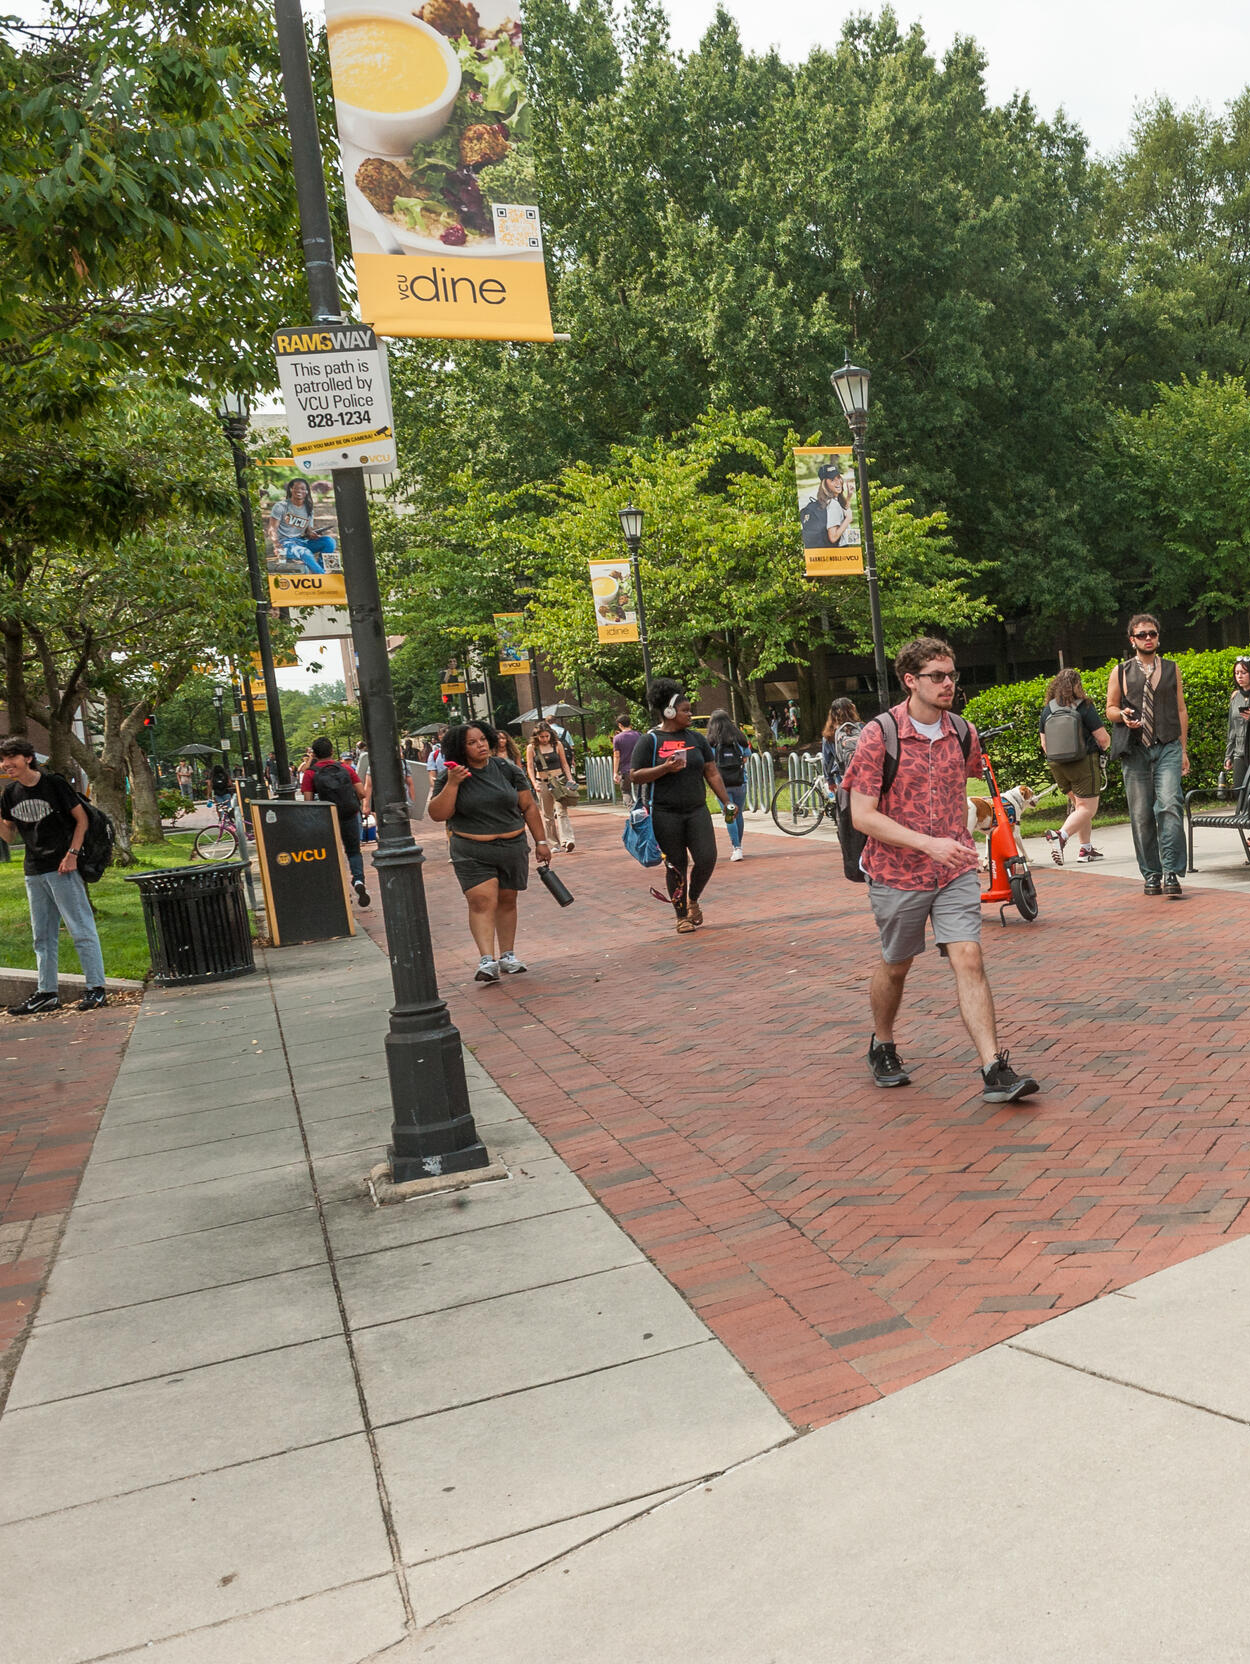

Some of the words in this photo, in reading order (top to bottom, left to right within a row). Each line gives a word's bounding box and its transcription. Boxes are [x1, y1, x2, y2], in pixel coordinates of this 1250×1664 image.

[397, 274, 410, 300] VCU
[410, 267, 506, 305] dine
[276, 330, 372, 353] RAMSWAY
[290, 362, 320, 376] This
[324, 360, 355, 378] path
[357, 359, 369, 373] is
[294, 376, 353, 396] patrolled
[356, 376, 373, 392] by
[297, 396, 330, 411] VCU
[333, 394, 374, 409] Police
[307, 410, 372, 428] 828-1234
[368, 454, 391, 462] VCU
[288, 514, 307, 528] VCU
[290, 578, 322, 589] VCU
[290, 848, 326, 863] VCU
